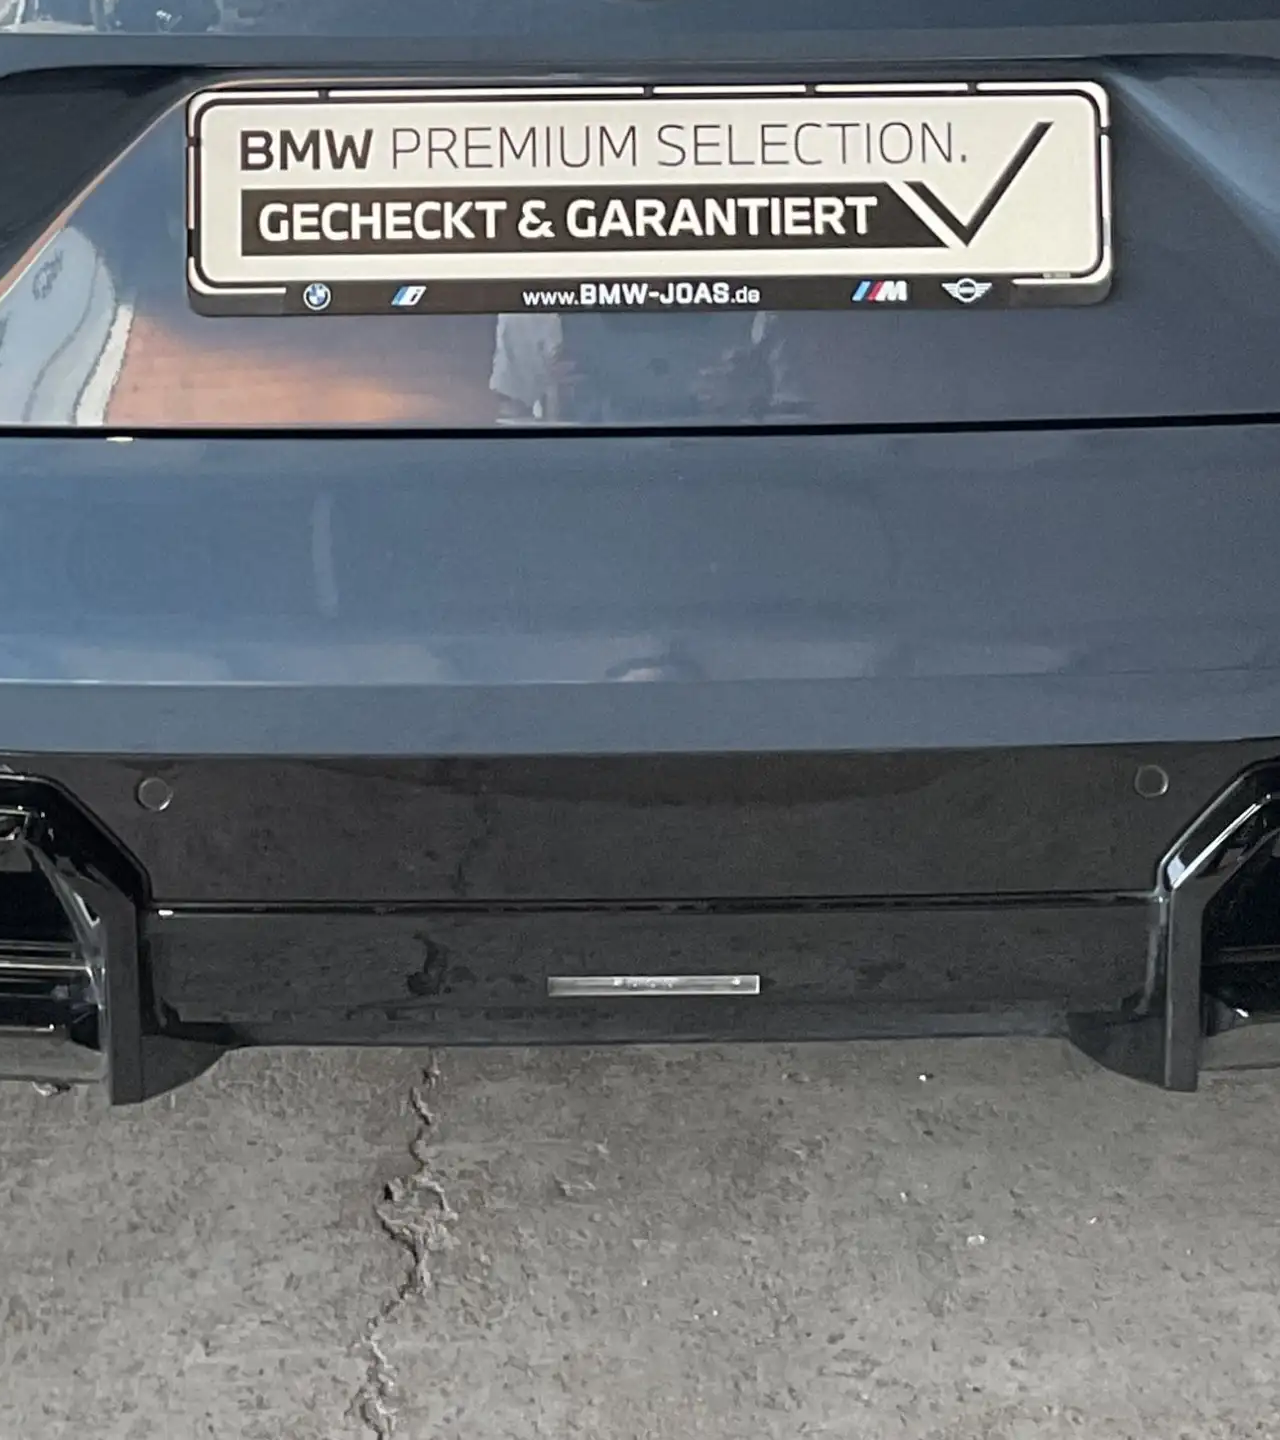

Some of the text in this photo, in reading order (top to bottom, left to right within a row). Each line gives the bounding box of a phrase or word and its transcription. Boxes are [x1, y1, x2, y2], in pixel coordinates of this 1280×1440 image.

[239, 121, 968, 171] BMW PREMIUM SELECTION.
[258, 195, 879, 242] GECHECKT & GARANTIERT
[522, 281, 761, 306] www.BMW-JOAS.de
